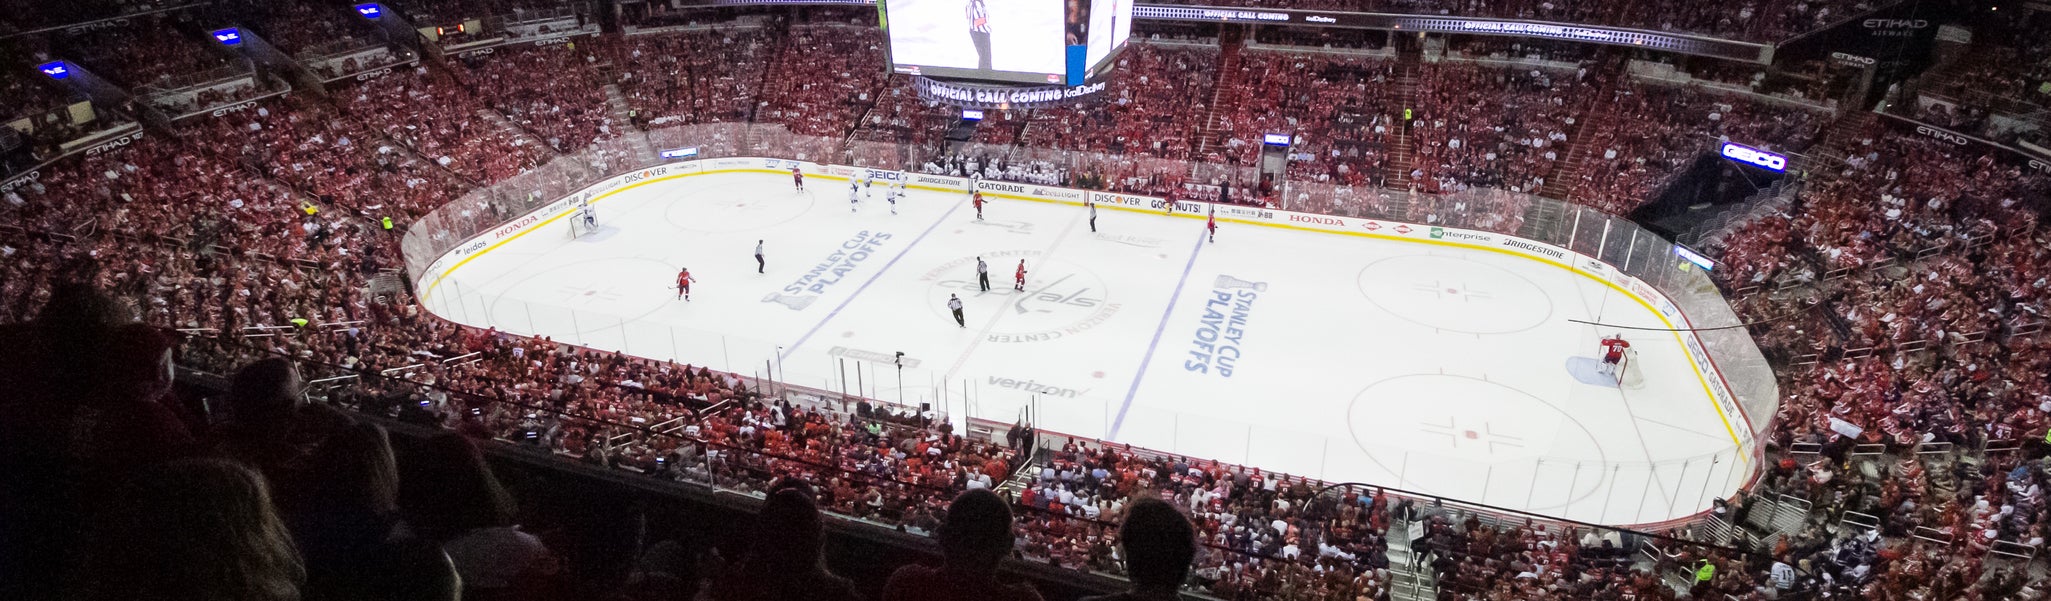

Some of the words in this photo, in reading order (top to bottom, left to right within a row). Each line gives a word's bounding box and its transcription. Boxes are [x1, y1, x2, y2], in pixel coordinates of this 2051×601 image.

[1205, 9, 1236, 18] OFFICIAL
[1238, 10, 1256, 19] CALL
[1257, 12, 1290, 20] COMING
[1464, 22, 1501, 30] OFFICIAL
[1503, 23, 1524, 32] CALL
[1526, 24, 1563, 34] COMING
[1862, 19, 1928, 28] ETIHAD
[459, 47, 494, 58] EIHAD
[1831, 51, 1876, 65] ETIHAD
[356, 67, 392, 81] ETIHAD
[930, 84, 974, 101] OFFICIAL
[977, 90, 1007, 103] CALL
[1010, 89, 1062, 102] COMING
[213, 101, 257, 117] ETIHAD
[1916, 125, 1967, 145] ETIHAD
[86, 137, 131, 156] ETIHAD
[1722, 143, 1786, 170] GEICO
[0, 170, 40, 193] ETIHAD
[624, 167, 667, 184] DISCOVER
[918, 176, 961, 187] BRIDGESTONE
[978, 182, 1025, 193] GATORADE
[1094, 193, 1140, 206] DISCOVER
[1175, 202, 1201, 213] NUTS!
[495, 215, 538, 238] HONDA
[1289, 214, 1345, 227] HONDA
[463, 240, 487, 256] leidos
[1503, 238, 1565, 260] BRIDGESTONE
[784, 249, 847, 294] STANLEY
[842, 230, 870, 250] CUP
[807, 231, 892, 295] PLAYOFFS
[1224, 289, 1257, 345] STANLEY
[987, 332, 1062, 343] CENTER
[1184, 290, 1232, 374] PLAYOFFS
[1612, 345, 1623, 353] 70
[1687, 333, 1709, 374] GEICO
[1215, 345, 1240, 378] CUP
[987, 375, 1077, 399] verizon
[1708, 371, 1735, 418] GATORADE
